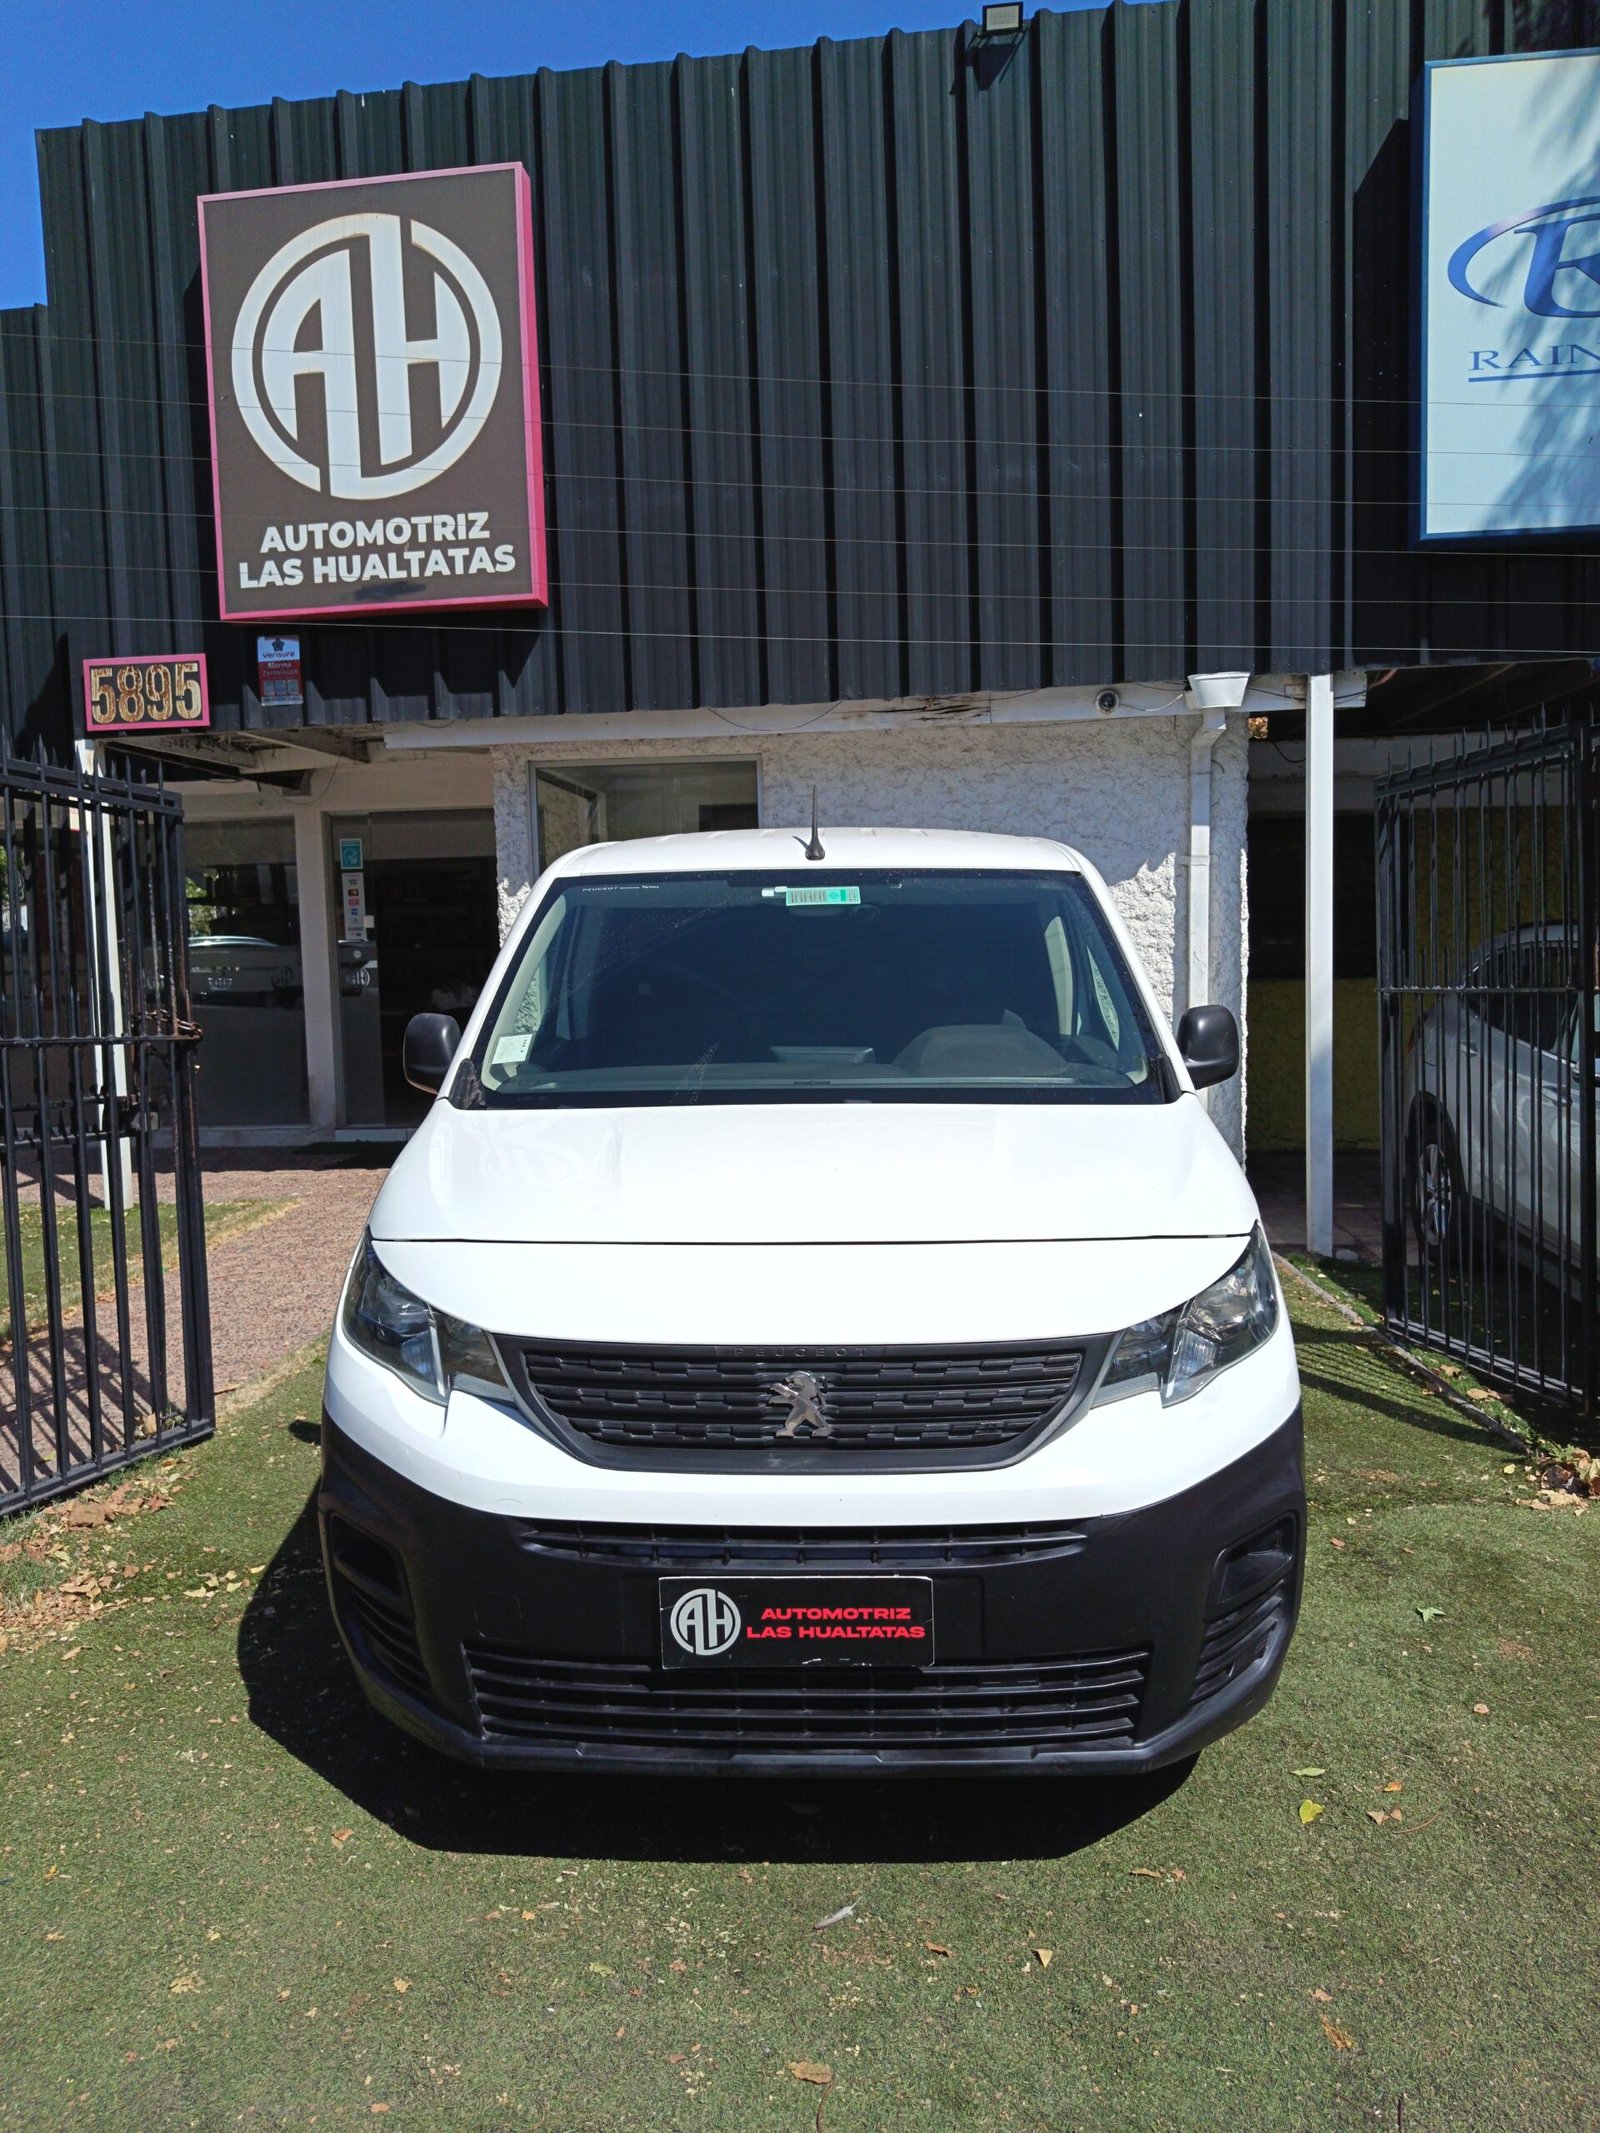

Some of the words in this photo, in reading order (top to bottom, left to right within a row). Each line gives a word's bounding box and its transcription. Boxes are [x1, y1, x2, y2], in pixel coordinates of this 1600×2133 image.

[260, 511, 490, 553] AUTOMOTRIZ
[239, 558, 304, 589] LAS
[313, 545, 517, 585] HUALTATAS
[90, 662, 202, 724] 5895
[734, 1347, 867, 1357] PEUGEOT
[760, 1607, 912, 1620] AUTOMOTRIZ
[746, 1626, 793, 1639] LAS
[799, 1626, 926, 1639] HUALTATAS
